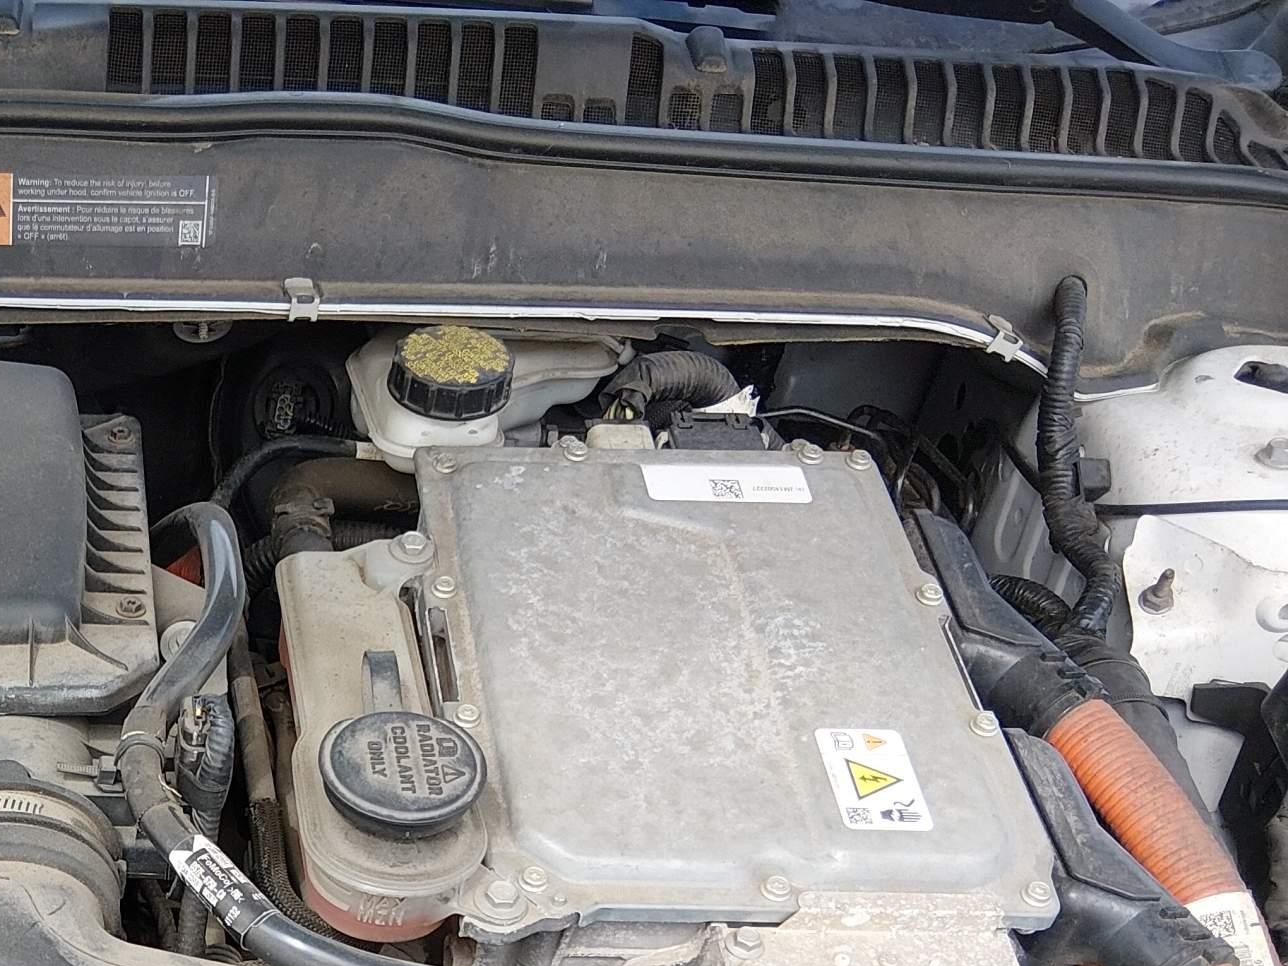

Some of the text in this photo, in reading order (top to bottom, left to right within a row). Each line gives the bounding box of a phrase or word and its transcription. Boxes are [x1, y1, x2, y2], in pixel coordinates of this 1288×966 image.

[18, 178, 51, 188] Warning:
[53, 178, 63, 186] To
[64, 179, 88, 187] reduce
[89, 179, 101, 187] the
[102, 179, 115, 187] risk
[117, 178, 125, 187] of
[148, 179, 172, 188] before
[17, 188, 46, 197] working
[47, 188, 67, 196] under
[90, 188, 117, 197] confirm
[118, 189, 143, 197] vehicle
[144, 189, 170, 198] ignition
[18, 204, 71, 213] Avertissement
[76, 206, 93, 214] Pour
[127, 207, 150, 215] risque
[17, 214, 30, 222] lors
[52, 215, 92, 223] intervention
[17, 224, 30, 232] que
[146, 225, 174, 234] position
[23, 232, 40, 240] OFF
[367, 740, 388, 778] ONLY
[390, 725, 416, 794] COOLANT
[416, 723, 443, 796] RADIATOR
[197, 853, 234, 888] FoMoCo
[360, 894, 408, 912] MAX
